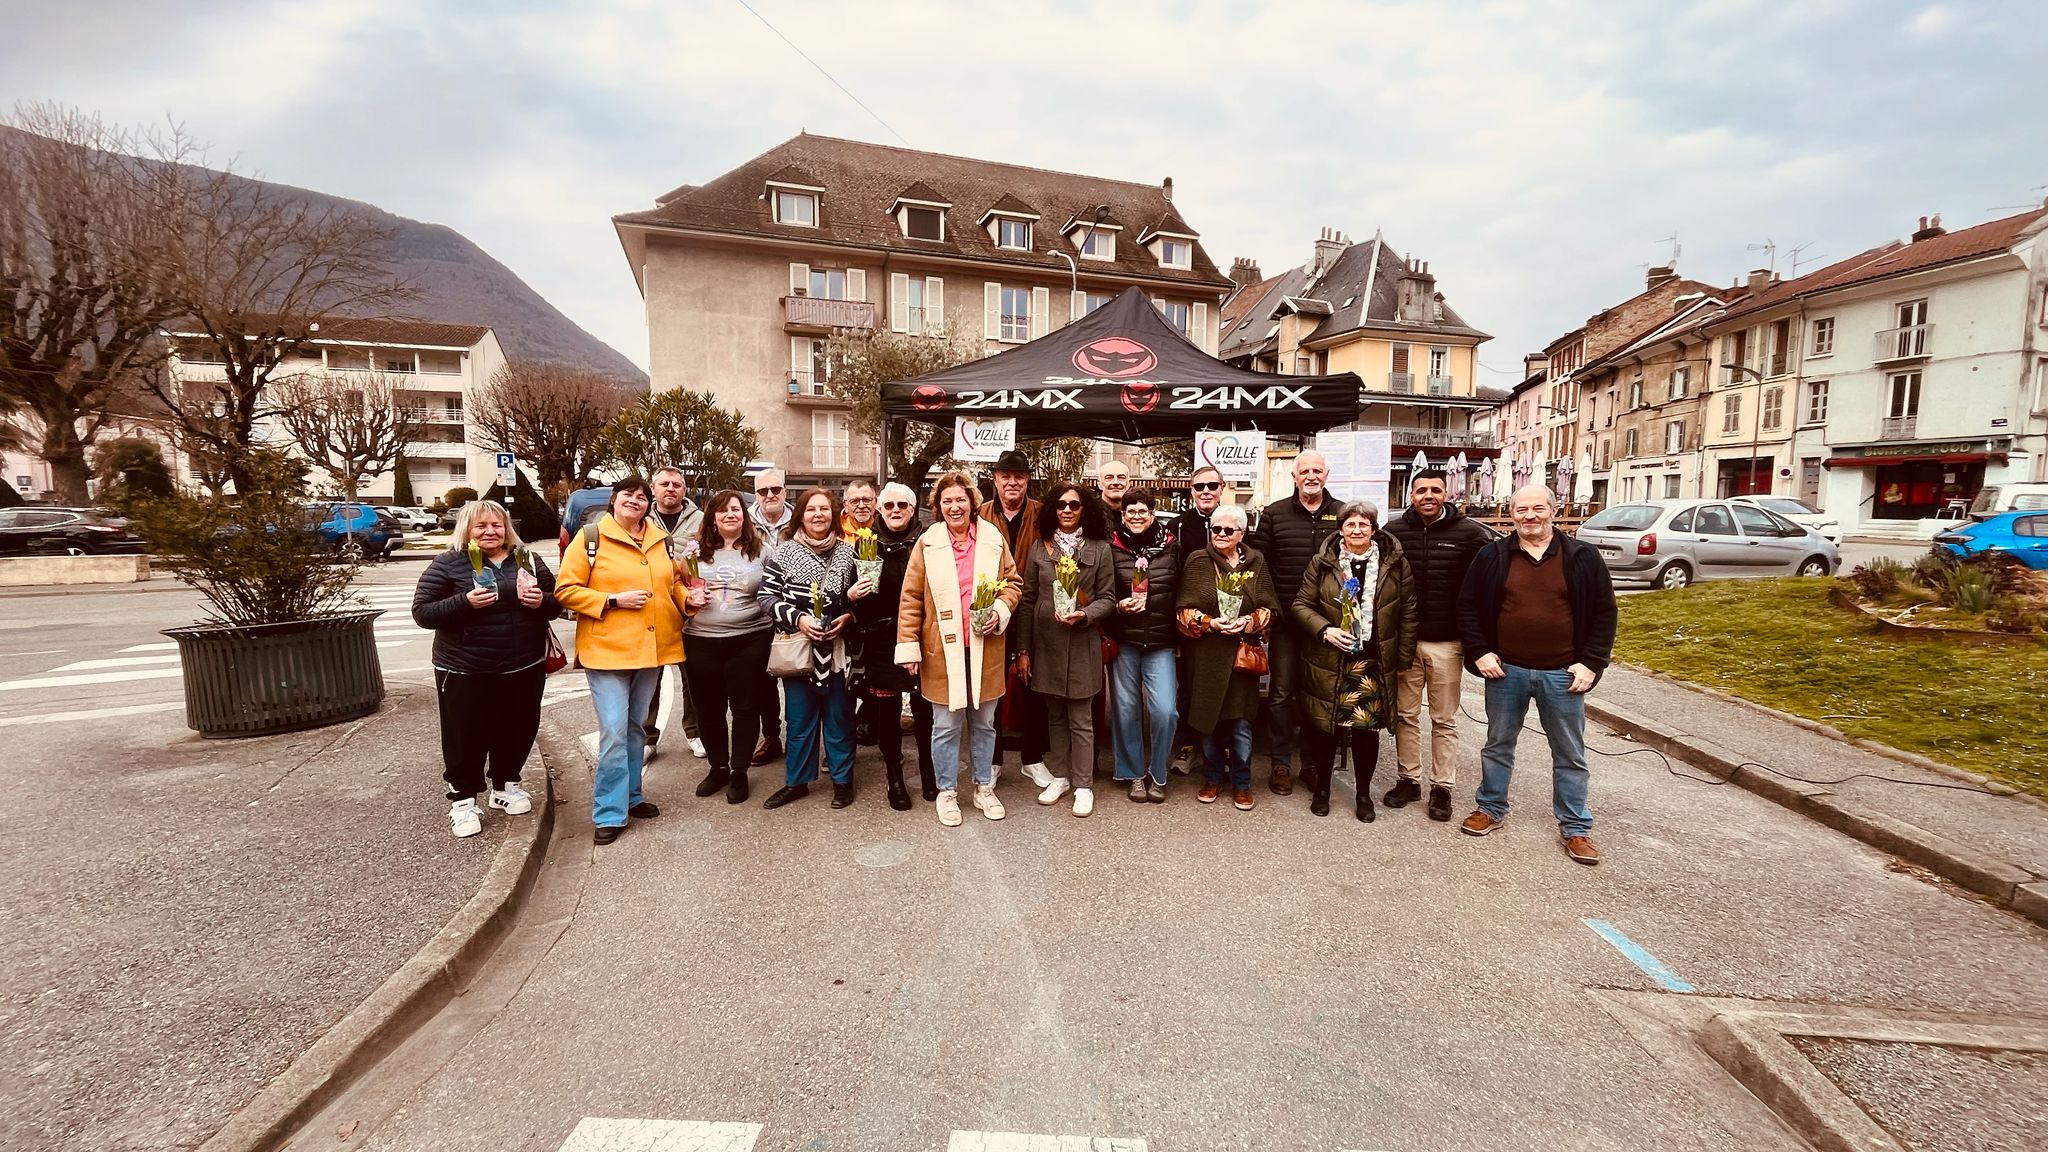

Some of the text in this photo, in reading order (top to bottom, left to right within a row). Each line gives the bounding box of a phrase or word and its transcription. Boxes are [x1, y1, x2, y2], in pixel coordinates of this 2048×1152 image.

[954, 388, 1085, 409] 24MX
[1169, 385, 1314, 410] 24MX
[974, 429, 1011, 441] VIZILLE
[1216, 446, 1259, 459] VIZILLE
[500, 455, 510, 467] P
